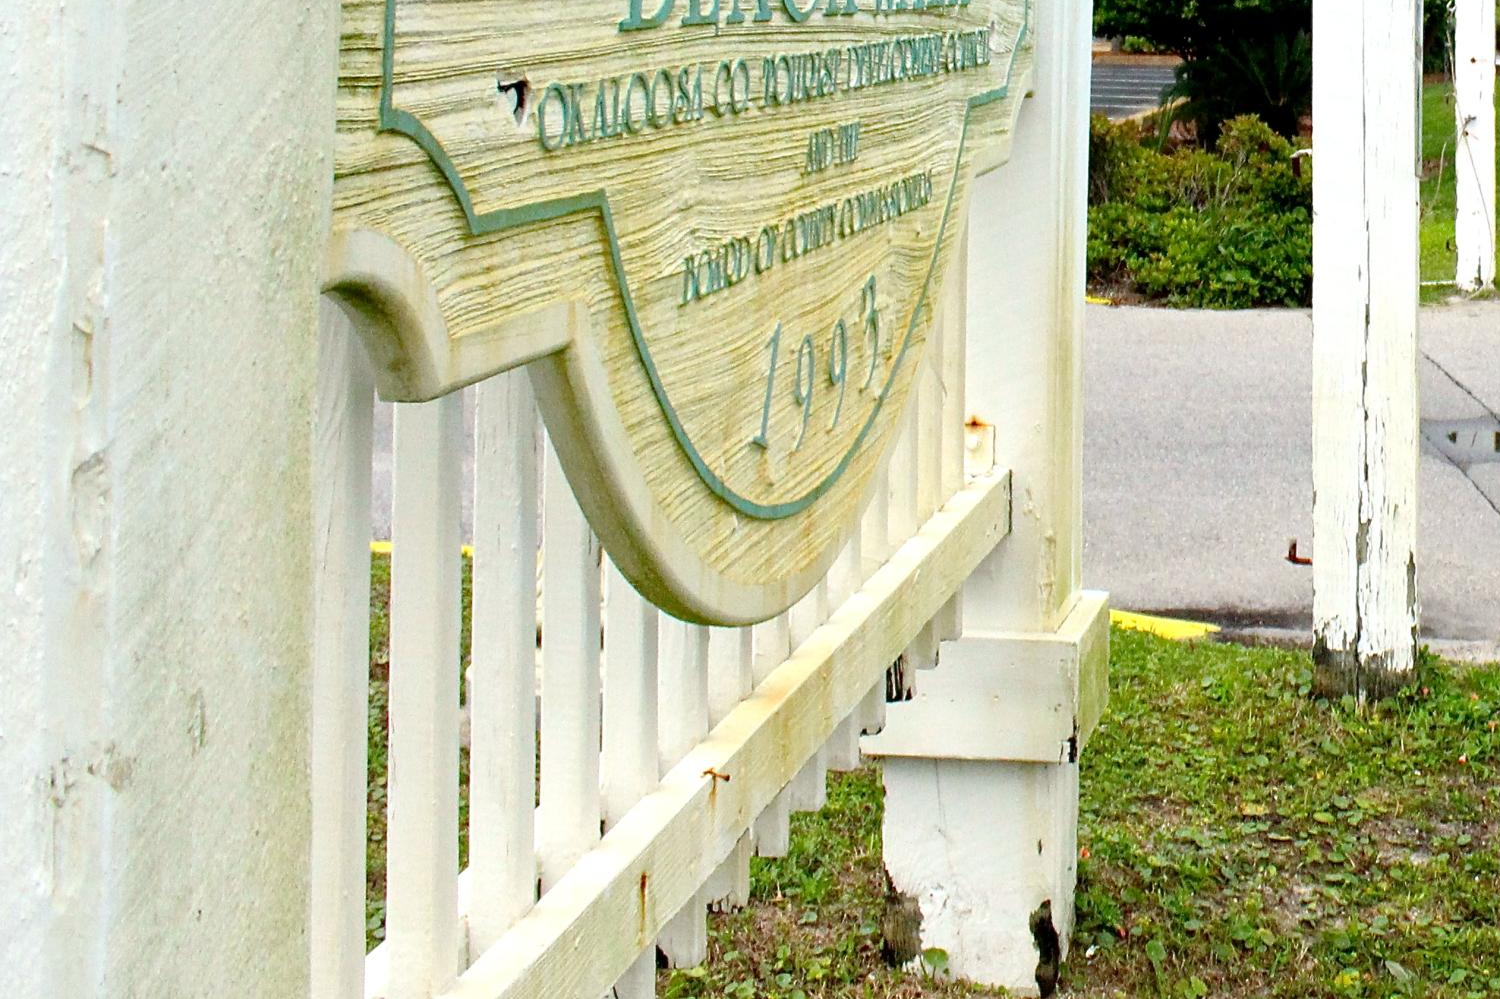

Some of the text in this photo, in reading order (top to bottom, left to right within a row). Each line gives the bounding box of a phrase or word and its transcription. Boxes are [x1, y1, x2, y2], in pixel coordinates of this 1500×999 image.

[538, 62, 704, 150] OKALOOSA
[763, 47, 841, 107] TOURIST
[847, 34, 942, 90] DEVELOPMENT
[680, 170, 932, 306] BOARD OF COUNTY COMMISSIONERS
